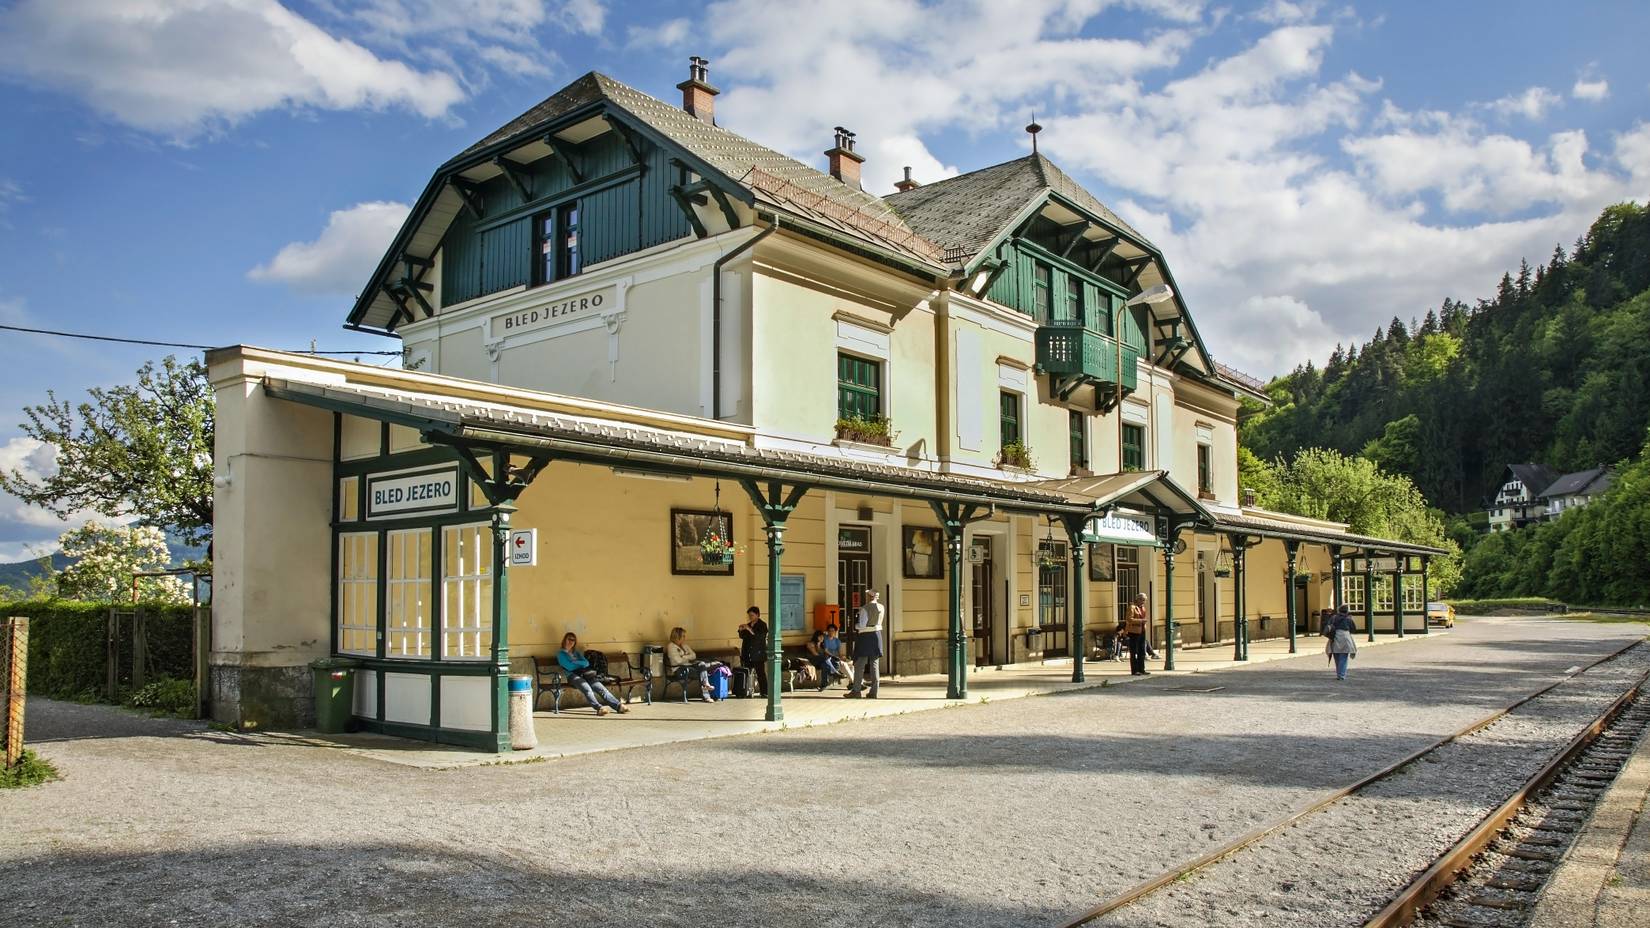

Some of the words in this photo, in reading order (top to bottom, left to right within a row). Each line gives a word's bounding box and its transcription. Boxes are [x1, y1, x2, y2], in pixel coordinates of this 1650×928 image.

[375, 488, 403, 505] BLED
[406, 480, 451, 502] JEZERO
[1102, 517, 1121, 529] BLED
[1123, 518, 1149, 532] JEZERO
[514, 552, 530, 560] IZHOD
